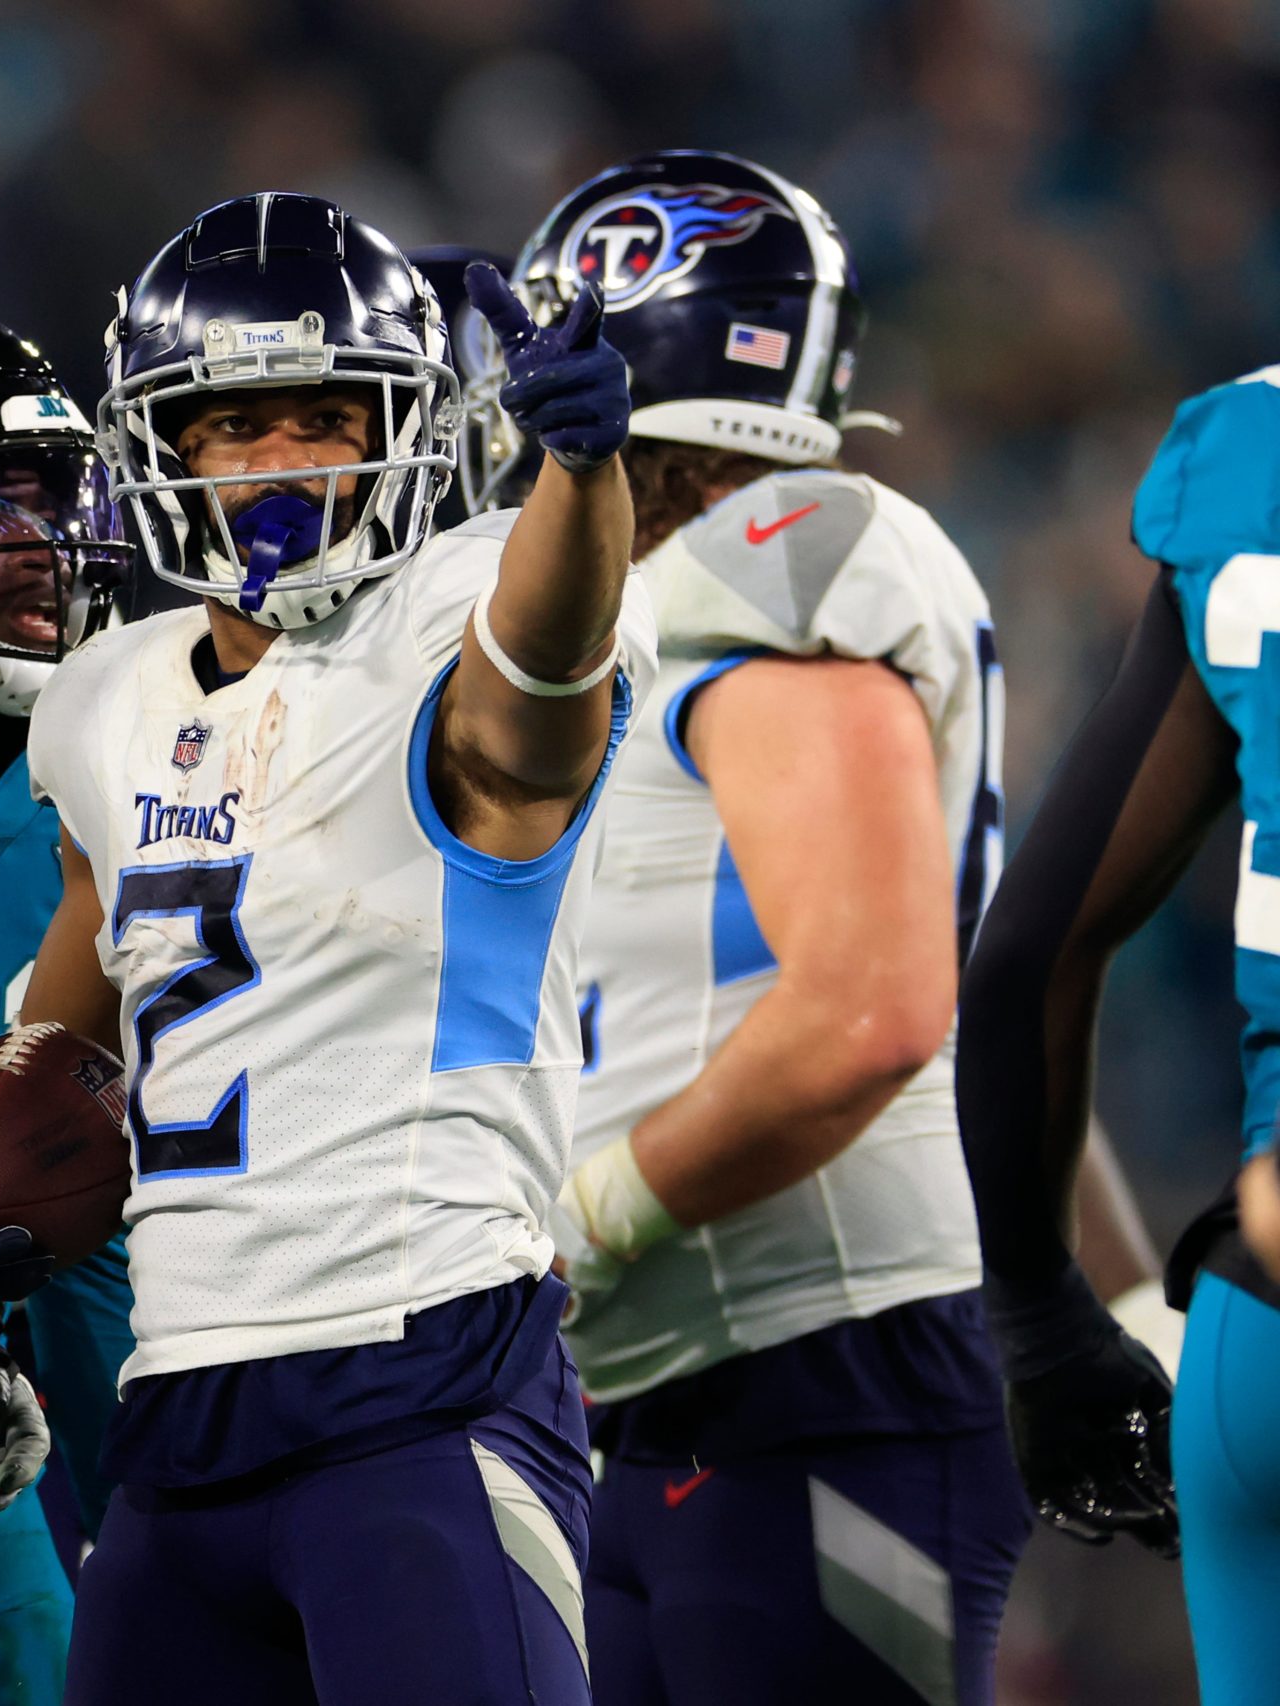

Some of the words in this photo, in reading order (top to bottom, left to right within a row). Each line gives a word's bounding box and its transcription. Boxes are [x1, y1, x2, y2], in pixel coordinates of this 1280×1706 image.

[243, 330, 284, 345] TITANS
[175, 742, 199, 763] NFL
[135, 792, 240, 850] TITANS
[112, 852, 262, 1184] 2
